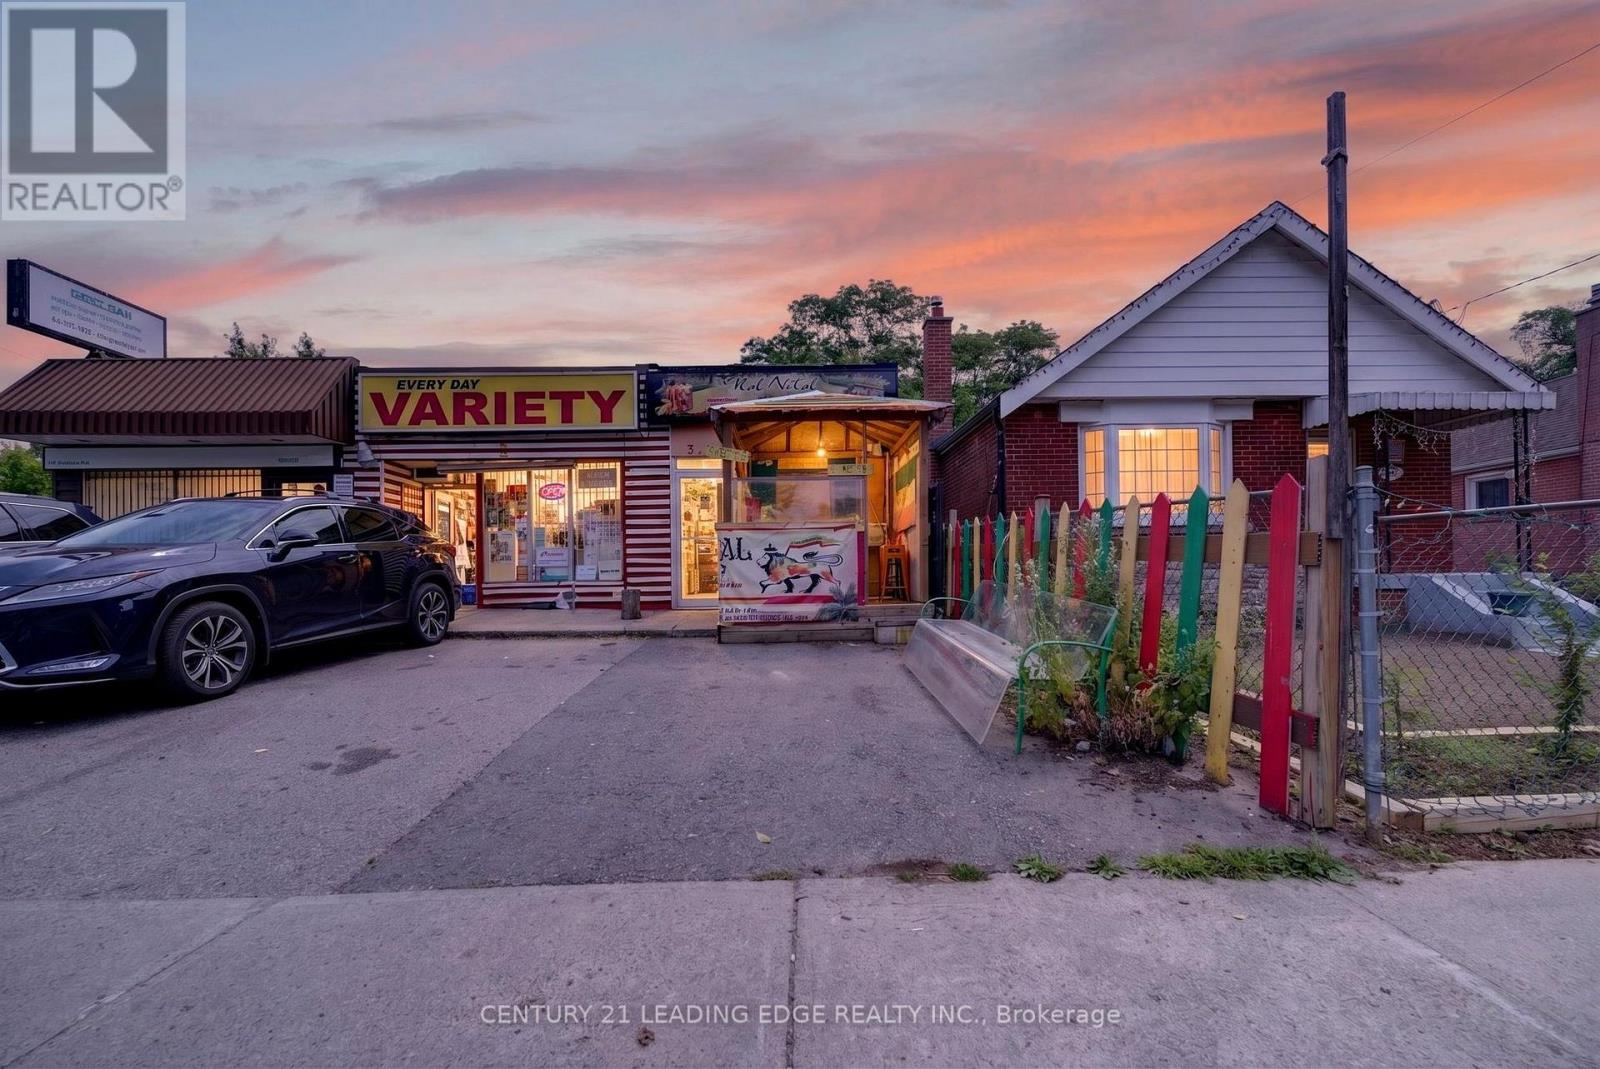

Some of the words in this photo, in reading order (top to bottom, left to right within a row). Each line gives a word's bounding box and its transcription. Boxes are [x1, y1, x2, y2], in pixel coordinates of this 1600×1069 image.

[396, 379, 447, 391] EVERY
[450, 379, 480, 390] DAY
[369, 390, 626, 426] VARIETY
[720, 537, 752, 561] AL
